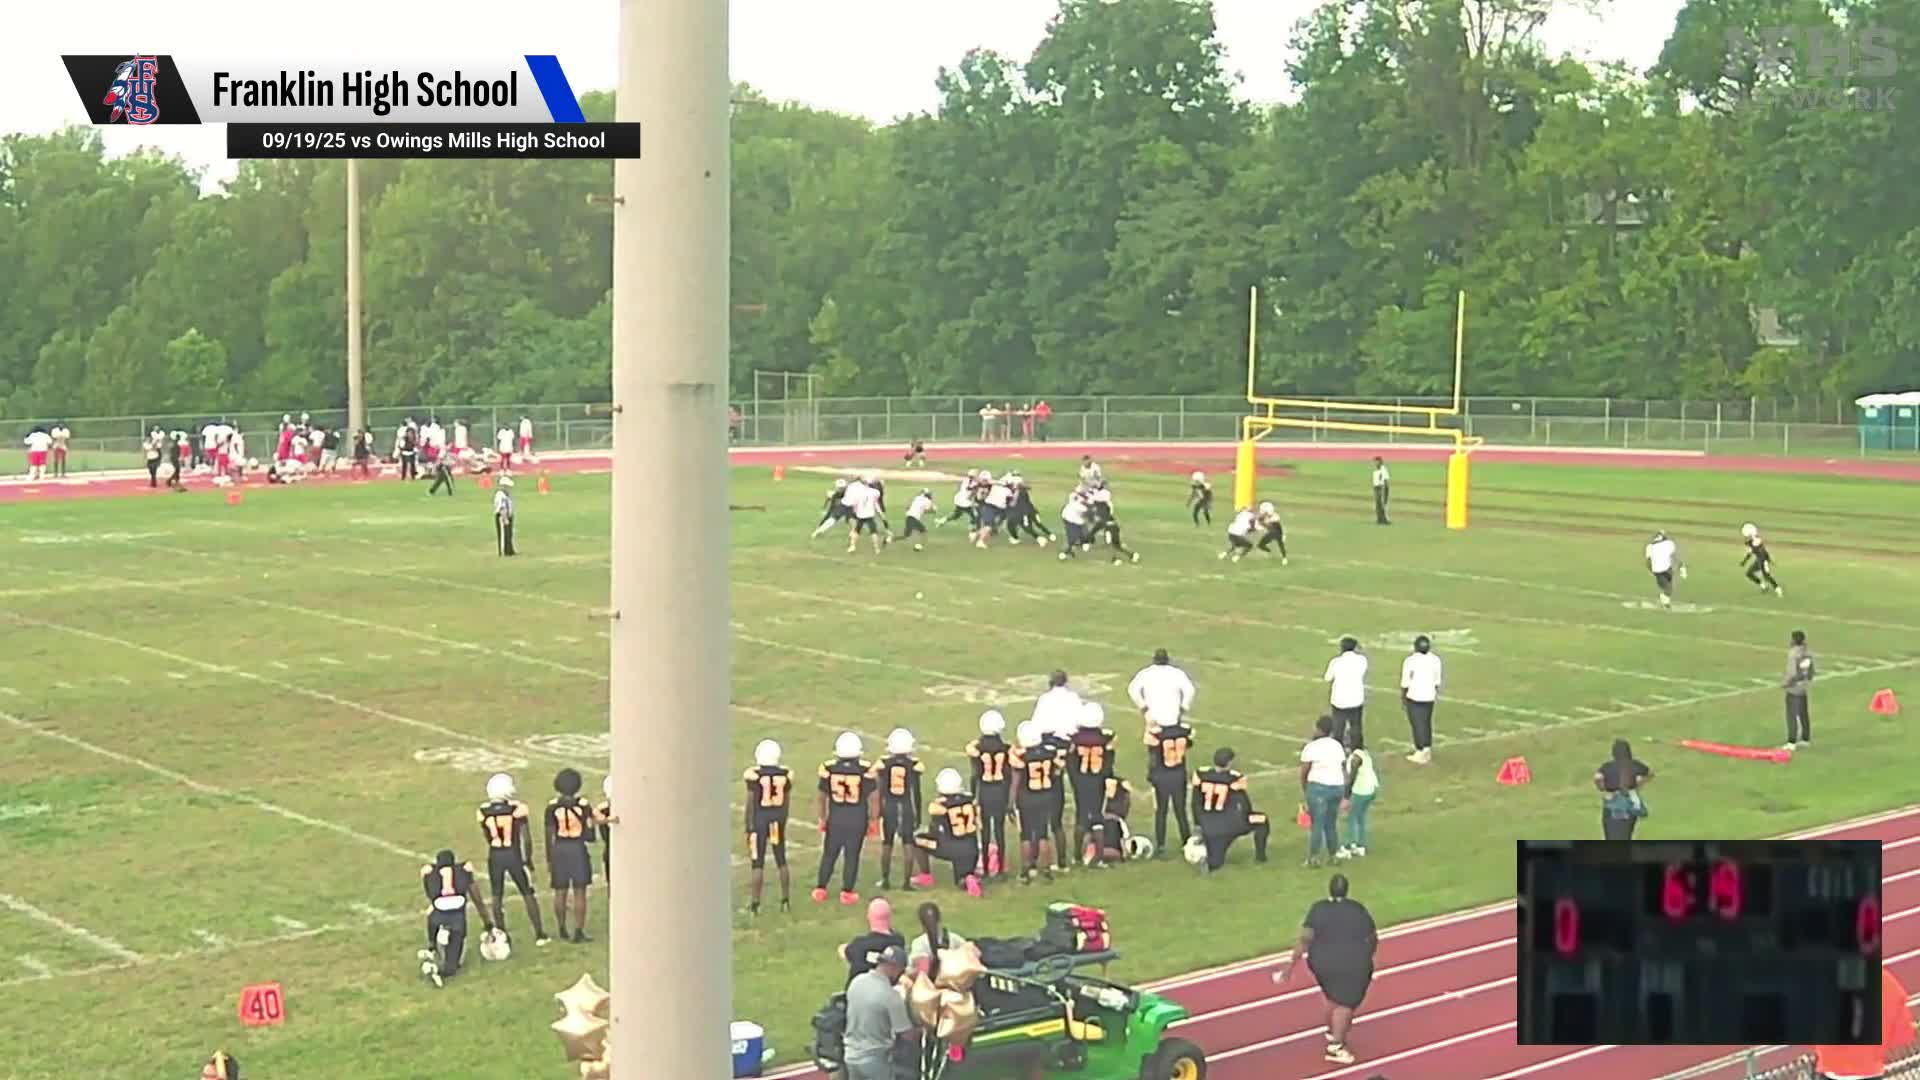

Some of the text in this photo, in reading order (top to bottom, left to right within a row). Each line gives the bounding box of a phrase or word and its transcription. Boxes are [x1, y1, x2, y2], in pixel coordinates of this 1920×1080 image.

[980, 752, 1006, 782] 11
[1201, 781, 1229, 811] 77
[485, 815, 513, 848] 17
[440, 866, 456, 896] 1
[250, 989, 280, 1020] 40
